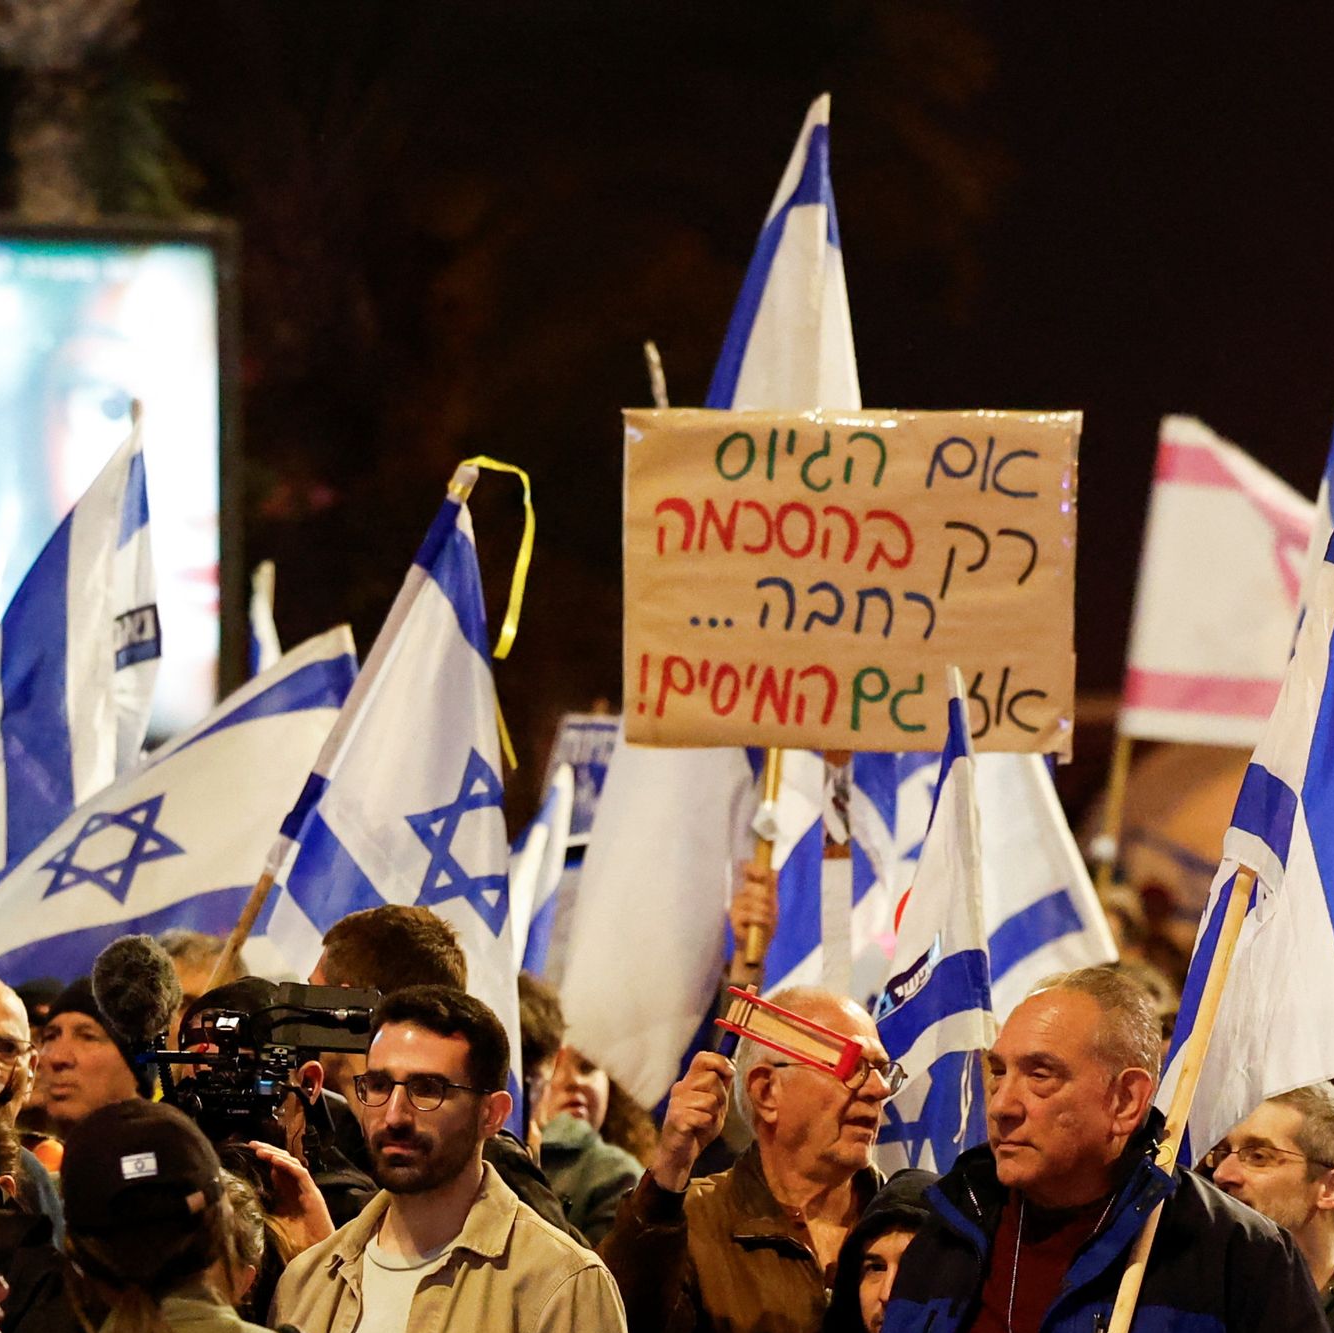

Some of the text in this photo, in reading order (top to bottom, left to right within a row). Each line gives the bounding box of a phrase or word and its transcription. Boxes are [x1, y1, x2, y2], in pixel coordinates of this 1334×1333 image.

[715, 427, 1040, 499] אם הגיוס
[654, 496, 1040, 600] רק בהסכמה
[637, 652, 1048, 740] אז גם המיסים!
